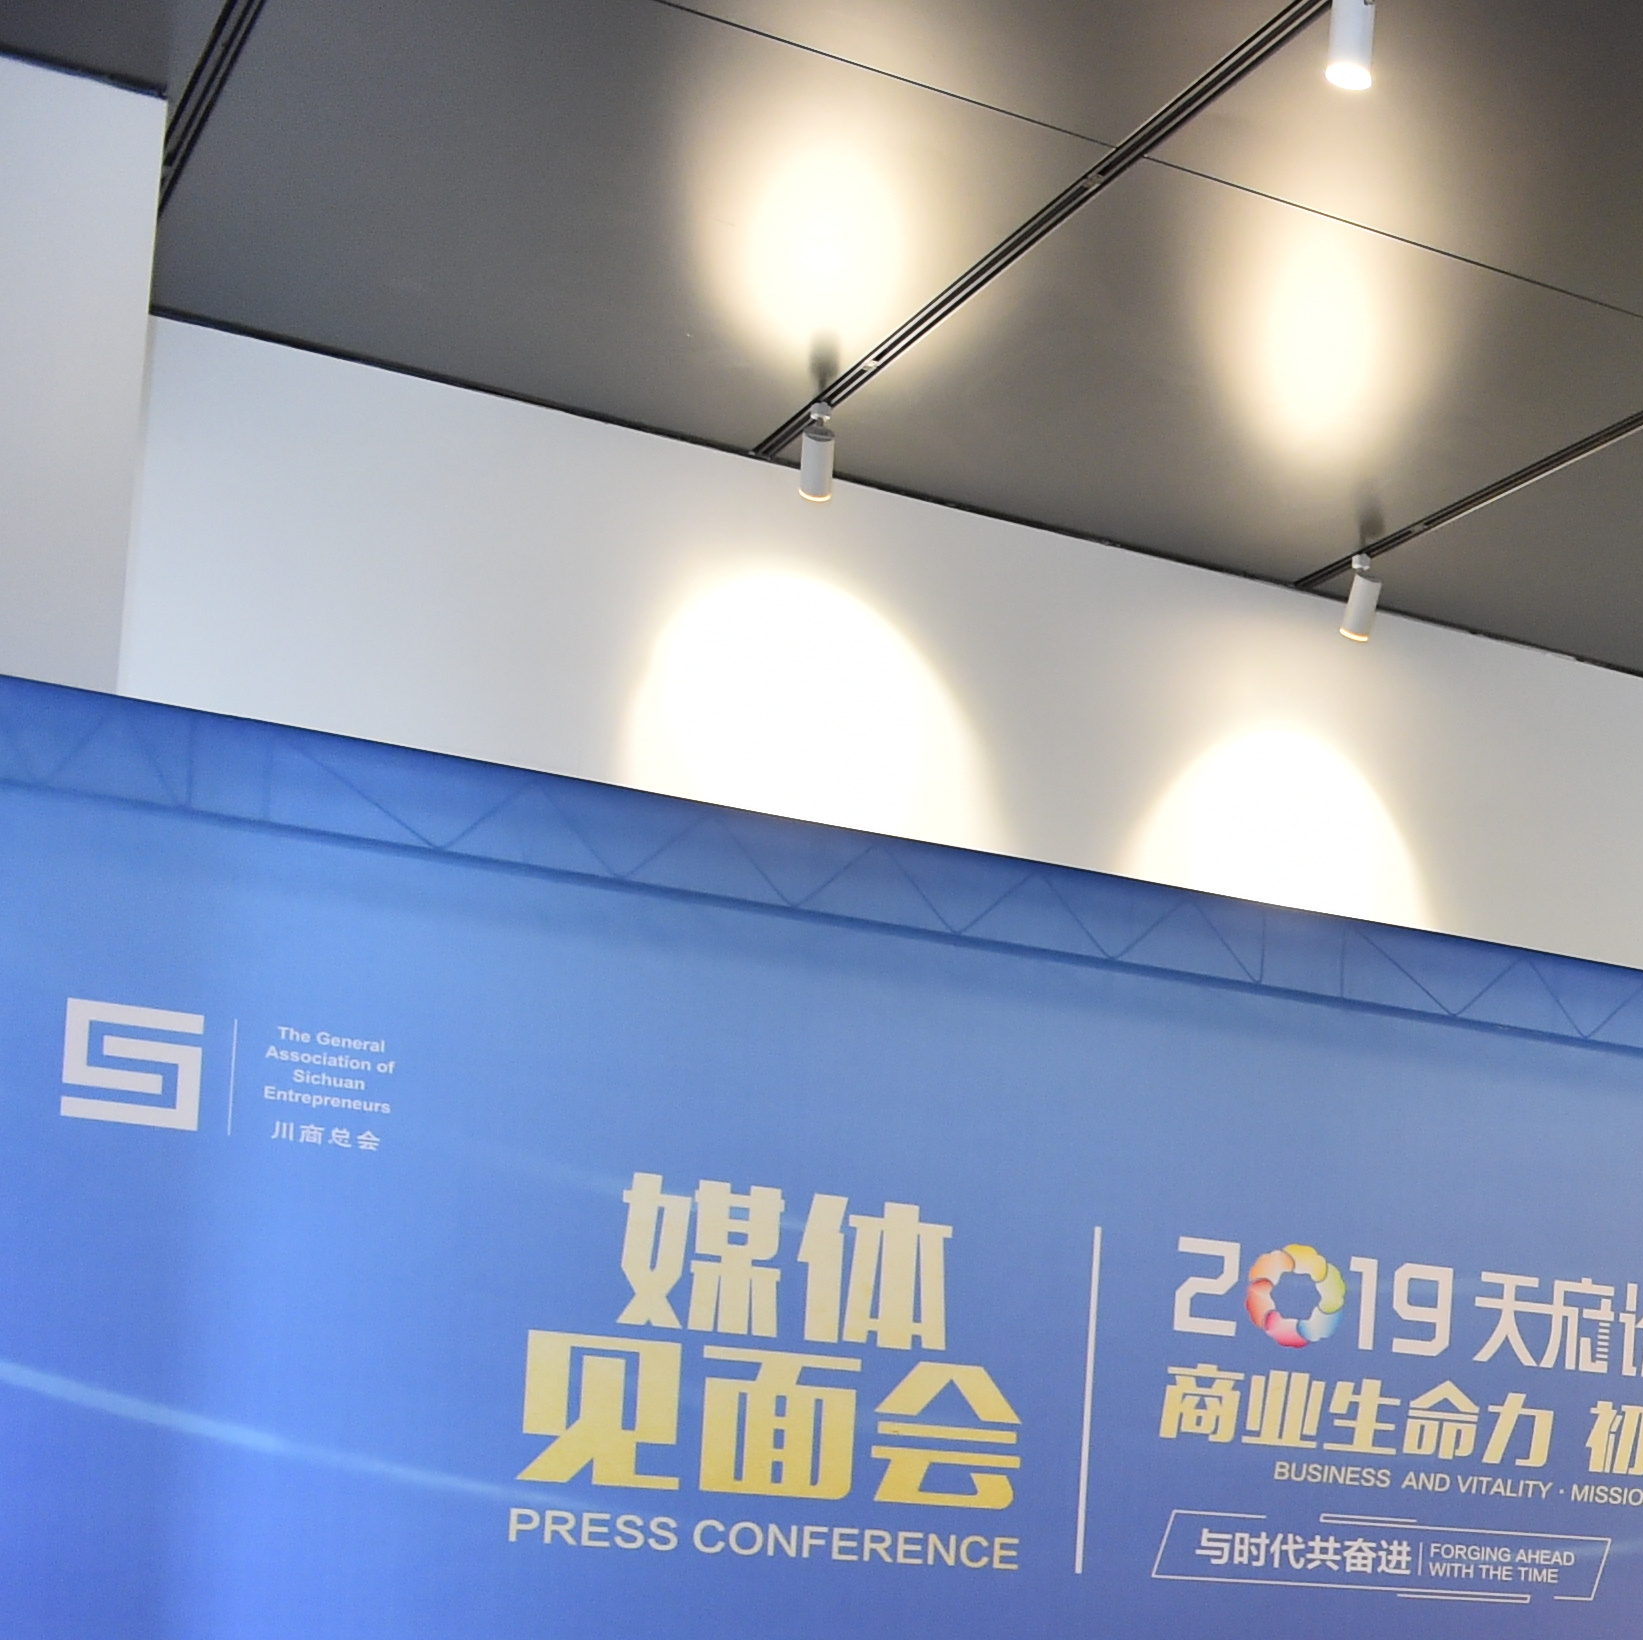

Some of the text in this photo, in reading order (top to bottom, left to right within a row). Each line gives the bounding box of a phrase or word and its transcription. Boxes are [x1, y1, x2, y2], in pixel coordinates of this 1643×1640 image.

[278, 1026, 385, 1053] The General
[265, 1045, 396, 1074] Association of
[292, 1068, 366, 1090] Sichuan
[263, 1085, 391, 1114] Entrepreneurs
[271, 1120, 380, 1151] 川商总会
[616, 1172, 953, 1350] 媒体
[516, 1329, 1022, 1510] 见面会
[1159, 1363, 1554, 1467] 商业生命力
[1273, 1462, 1391, 1488] BUSINESS
[1402, 1471, 1450, 1492] AND
[1458, 1476, 1553, 1499] VITALITY
[508, 1507, 1020, 1571] PRESS CONFERENCE
[1195, 1528, 1412, 1575] 与时代共奋进
[1430, 1543, 1576, 1566] FORGING AHEAD
[1429, 1562, 1559, 1584] WITH THE TIME
